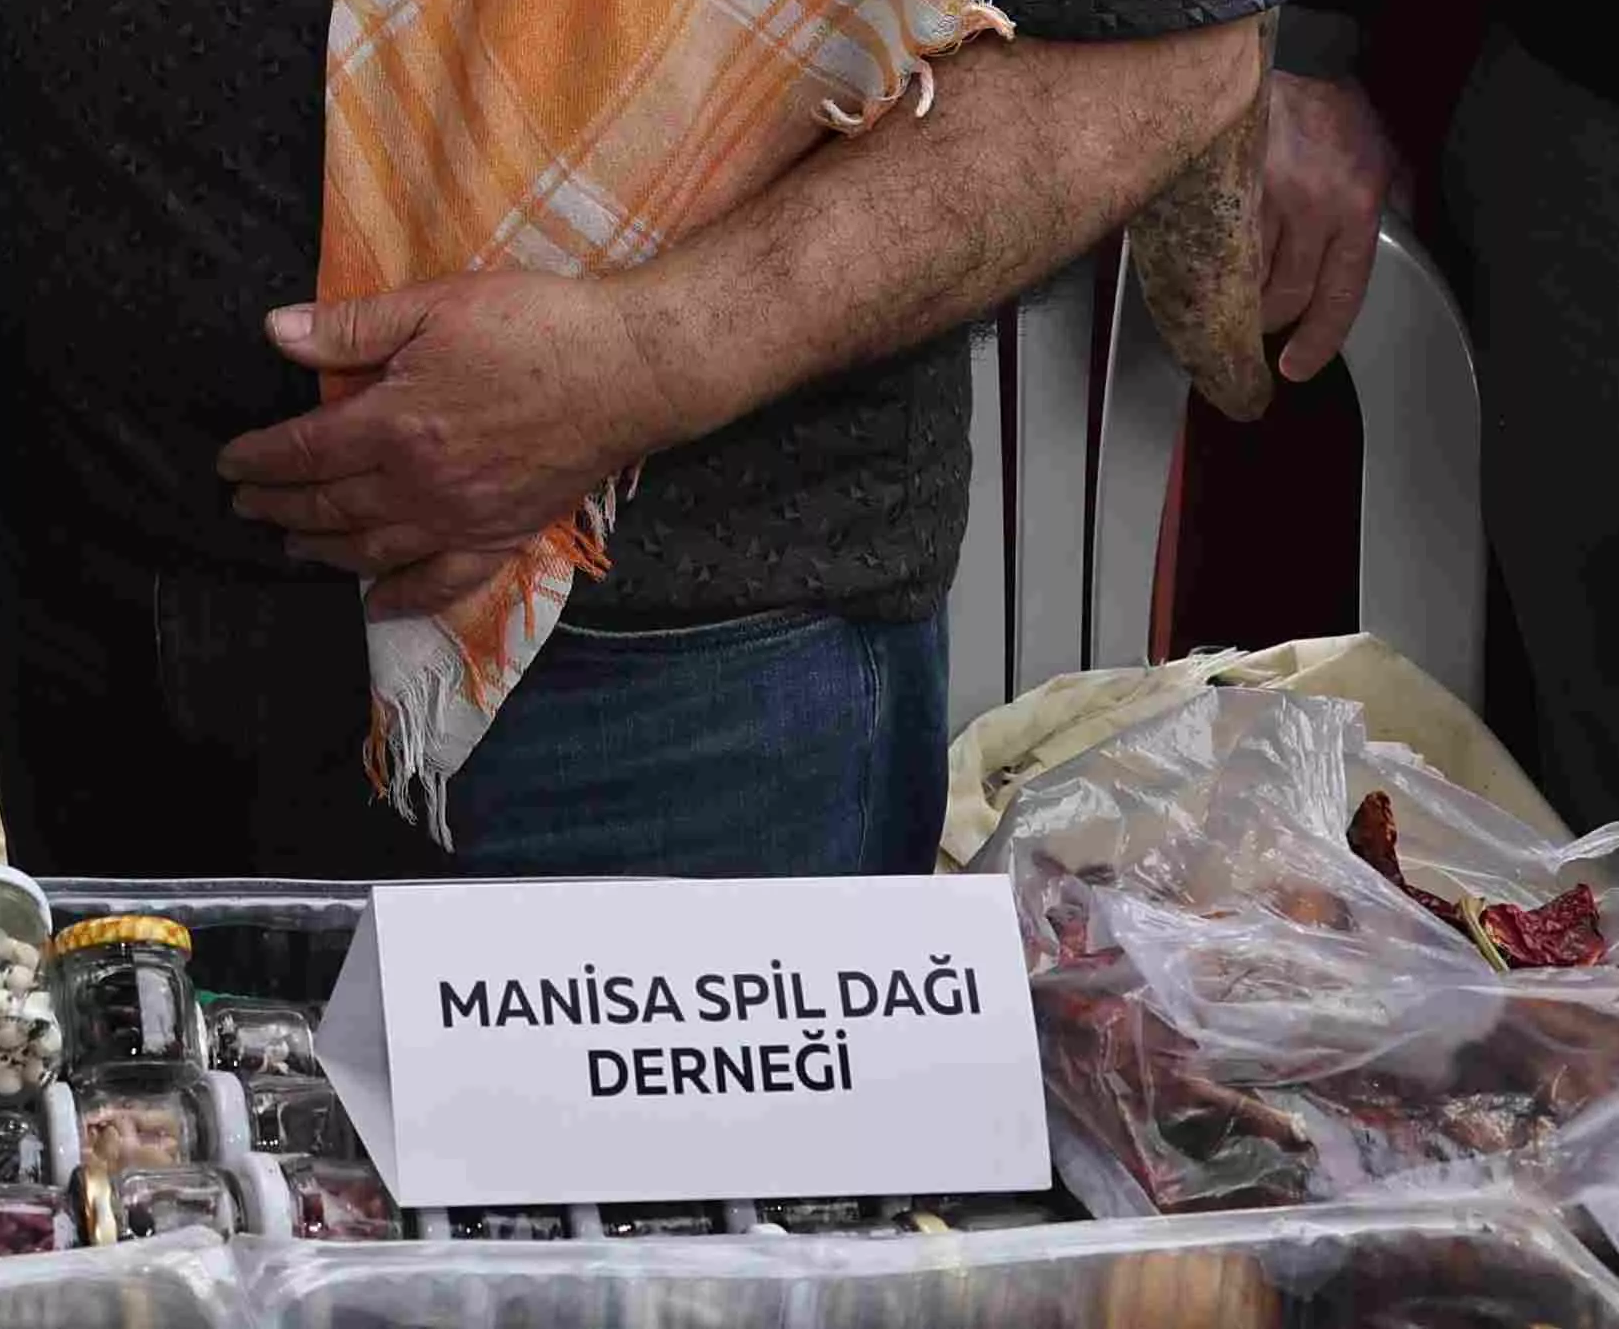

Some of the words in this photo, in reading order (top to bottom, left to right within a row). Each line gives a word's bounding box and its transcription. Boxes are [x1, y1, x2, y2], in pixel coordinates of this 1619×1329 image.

[438, 962, 686, 1029] MANİSA
[695, 958, 827, 1022] SPİL
[837, 953, 982, 1018] DAĞI
[586, 1028, 853, 1098] DERNEĞİ
